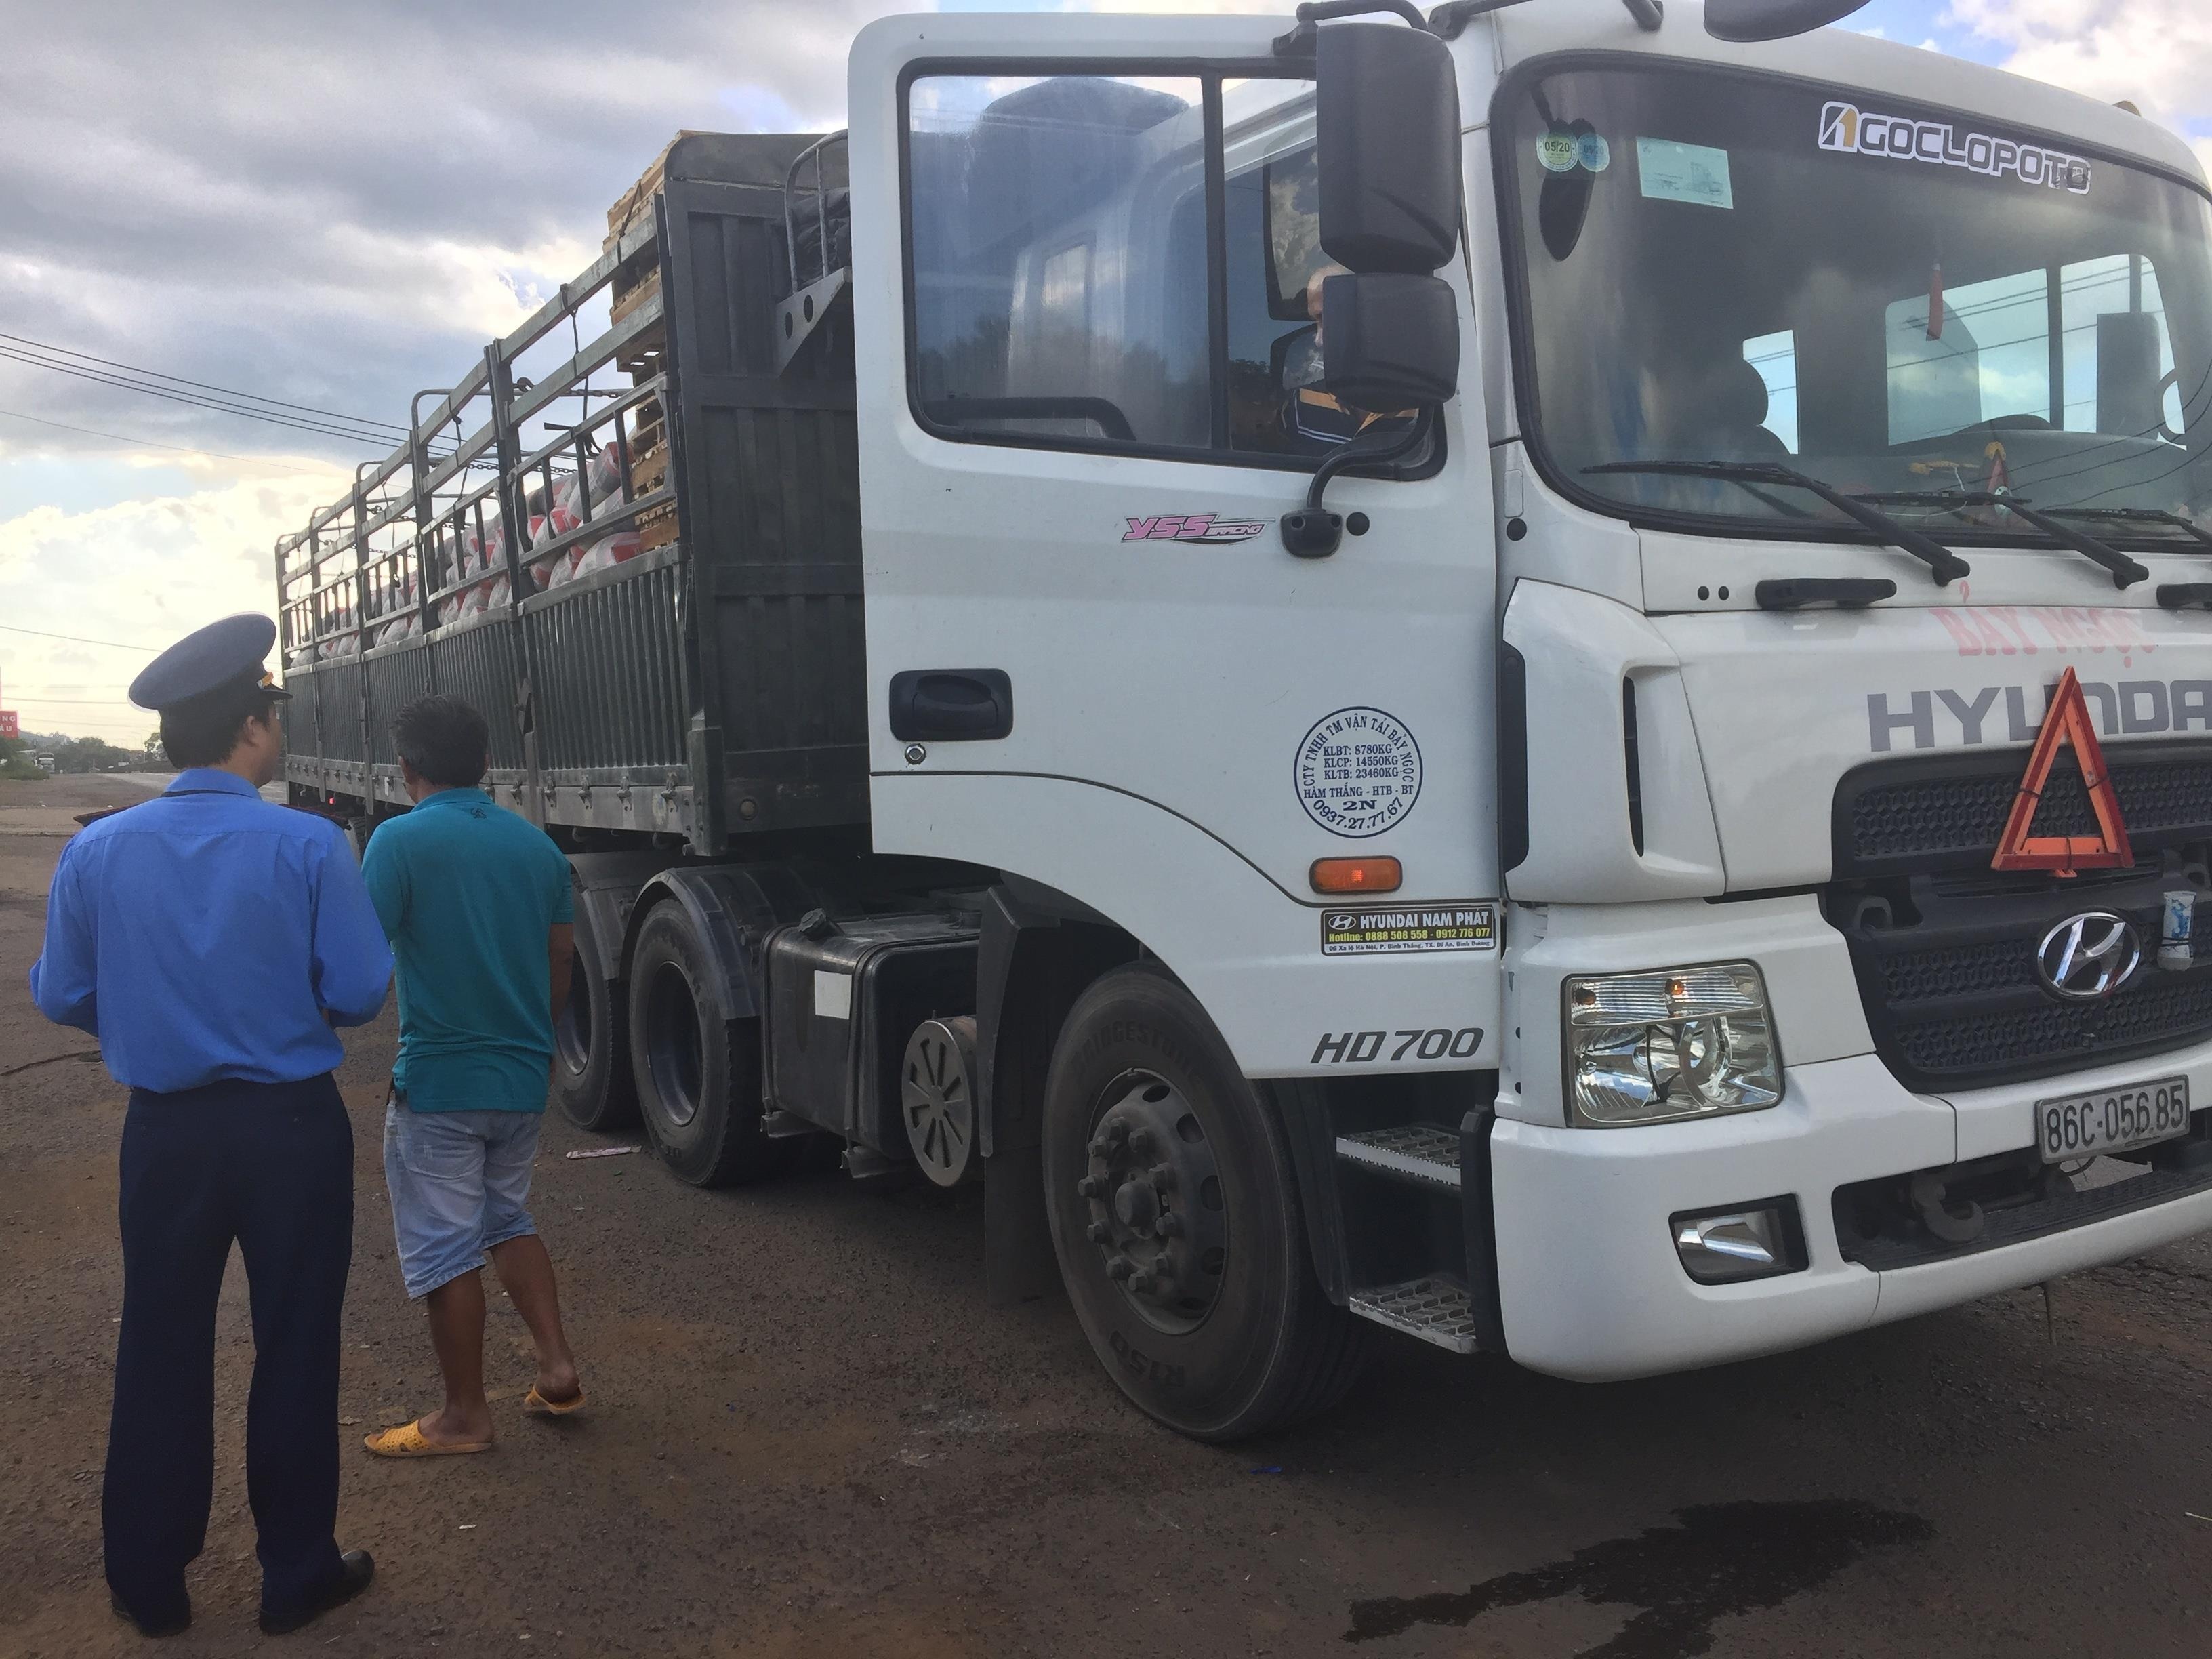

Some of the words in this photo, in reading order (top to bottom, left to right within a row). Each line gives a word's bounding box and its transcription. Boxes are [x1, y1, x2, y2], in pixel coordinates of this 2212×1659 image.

[1544, 141, 1570, 152] 05/20
[1122, 514, 1219, 541] YSS
[1326, 720, 1344, 736] TM
[1345, 713, 1368, 731] VẬN
[1305, 732, 1328, 762] TNHH
[1323, 745, 1351, 756] KLBT:
[1355, 744, 1393, 755] 8780KG
[1324, 758, 1352, 768] KLCP:
[1356, 755, 1398, 766] 14550KG
[1400, 752, 1414, 782] NGỌC
[1303, 764, 1315, 786] CTY
[1324, 769, 1353, 780] KLTB:
[1356, 767, 1399, 779] 23460KG
[1303, 785, 1326, 798] HÀM
[1329, 781, 1363, 798] THẮNG
[1372, 785, 1393, 796] HTB
[1401, 785, 1414, 795] BT
[1313, 796, 1404, 830] 0937.27.77.67
[1343, 800, 1377, 811] 2N
[1360, 913, 1418, 929] HYUNDAI
[1423, 912, 1452, 927] NAM
[1456, 908, 1489, 926] PHÁT
[1329, 932, 1364, 942] Hotline:
[1365, 930, 1389, 941] 0888
[1391, 930, 1408, 940] 508
[1410, 930, 1428, 939] 558
[1436, 928, 1456, 939] 0912
[1459, 928, 1473, 937] 776
[1475, 927, 1490, 937] 077
[1310, 1031, 1387, 1063] HD
[1390, 1027, 1484, 1061] 700
